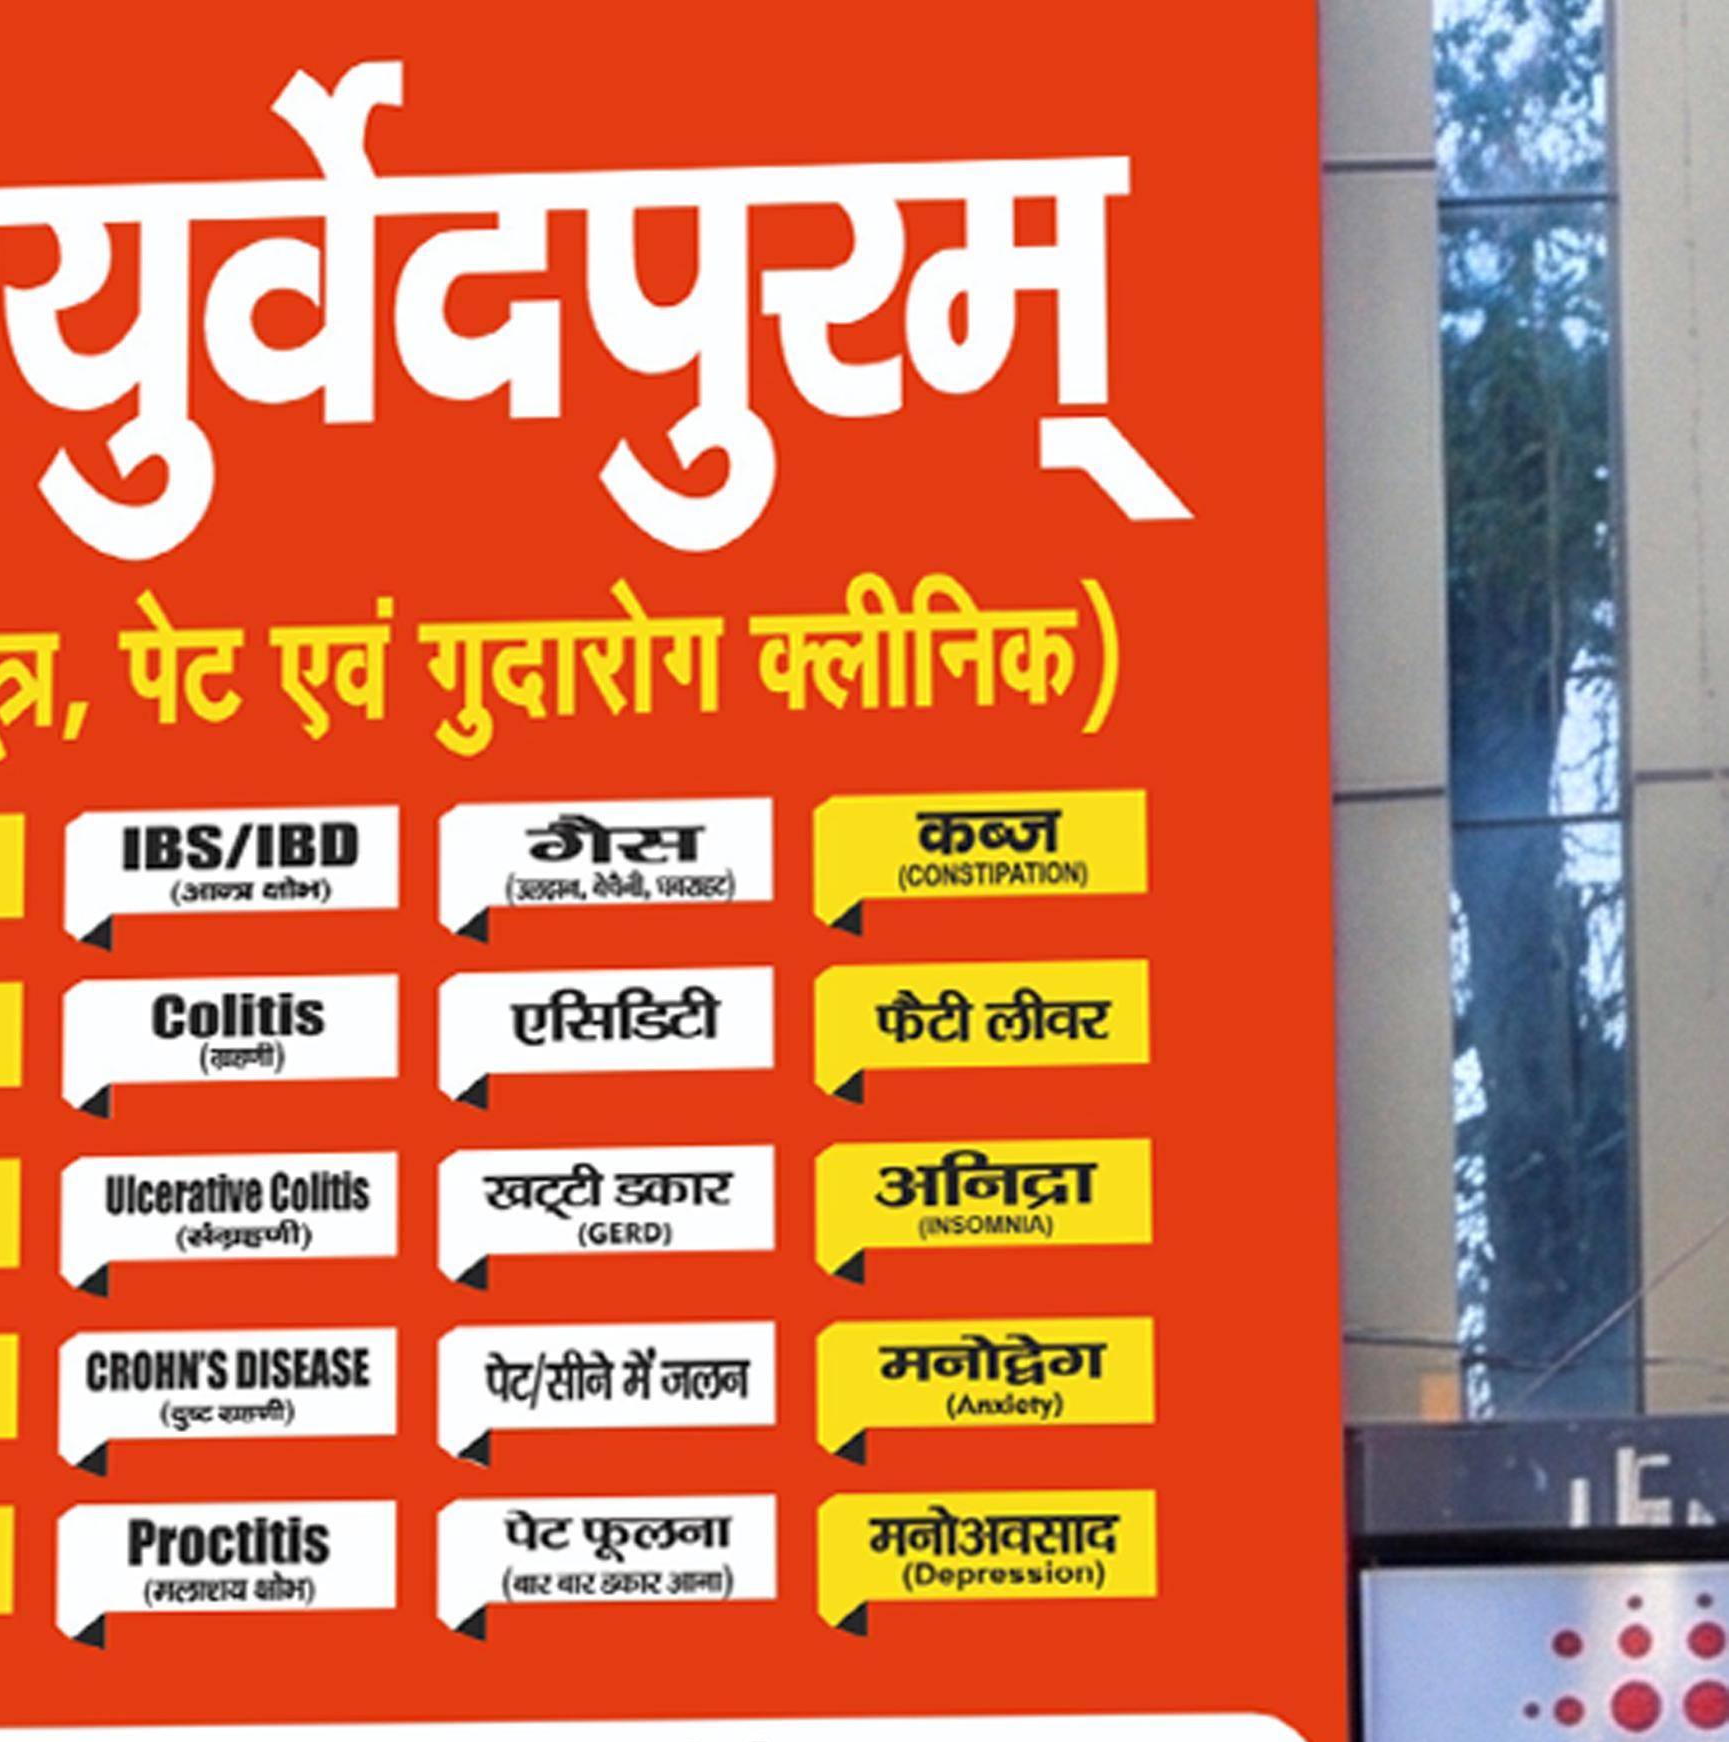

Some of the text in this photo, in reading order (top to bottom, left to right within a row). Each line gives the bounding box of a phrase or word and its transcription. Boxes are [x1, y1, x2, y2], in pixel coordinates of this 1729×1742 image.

[120, 589, 244, 724] पेट
[268, 596, 393, 740] एवं
[418, 580, 723, 754] गुदारोग
[750, 571, 1122, 735] क्लीनिक)
[121, 820, 360, 871] IBS/IBD
[525, 813, 705, 864] गैस
[916, 809, 1062, 855] कब्ज
[898, 861, 1088, 891] (CONSTIPATION)
[152, 992, 325, 1039] Colitis
[510, 985, 721, 1046] एसिडिटी
[875, 989, 1112, 1044] फैटी लीवर
[105, 1170, 371, 1216] Ulcerative Colitis
[614, 1170, 734, 1207] डकार
[874, 1150, 1098, 1209] अनिद्रा
[578, 1220, 673, 1248] (GERD)
[918, 1214, 1054, 1241] (INSOMNIA)
[85, 1347, 371, 1392] CROHN'S DISEASE
[485, 1348, 750, 1409] पेट/सीने में जलन
[946, 1392, 1064, 1420] (Anxiety)
[128, 1515, 330, 1568] Proctitis
[504, 1510, 733, 1563] पेट फूलना
[869, 1505, 1122, 1558] मनोअवसाद
[903, 1562, 1106, 1591] (Depression)
